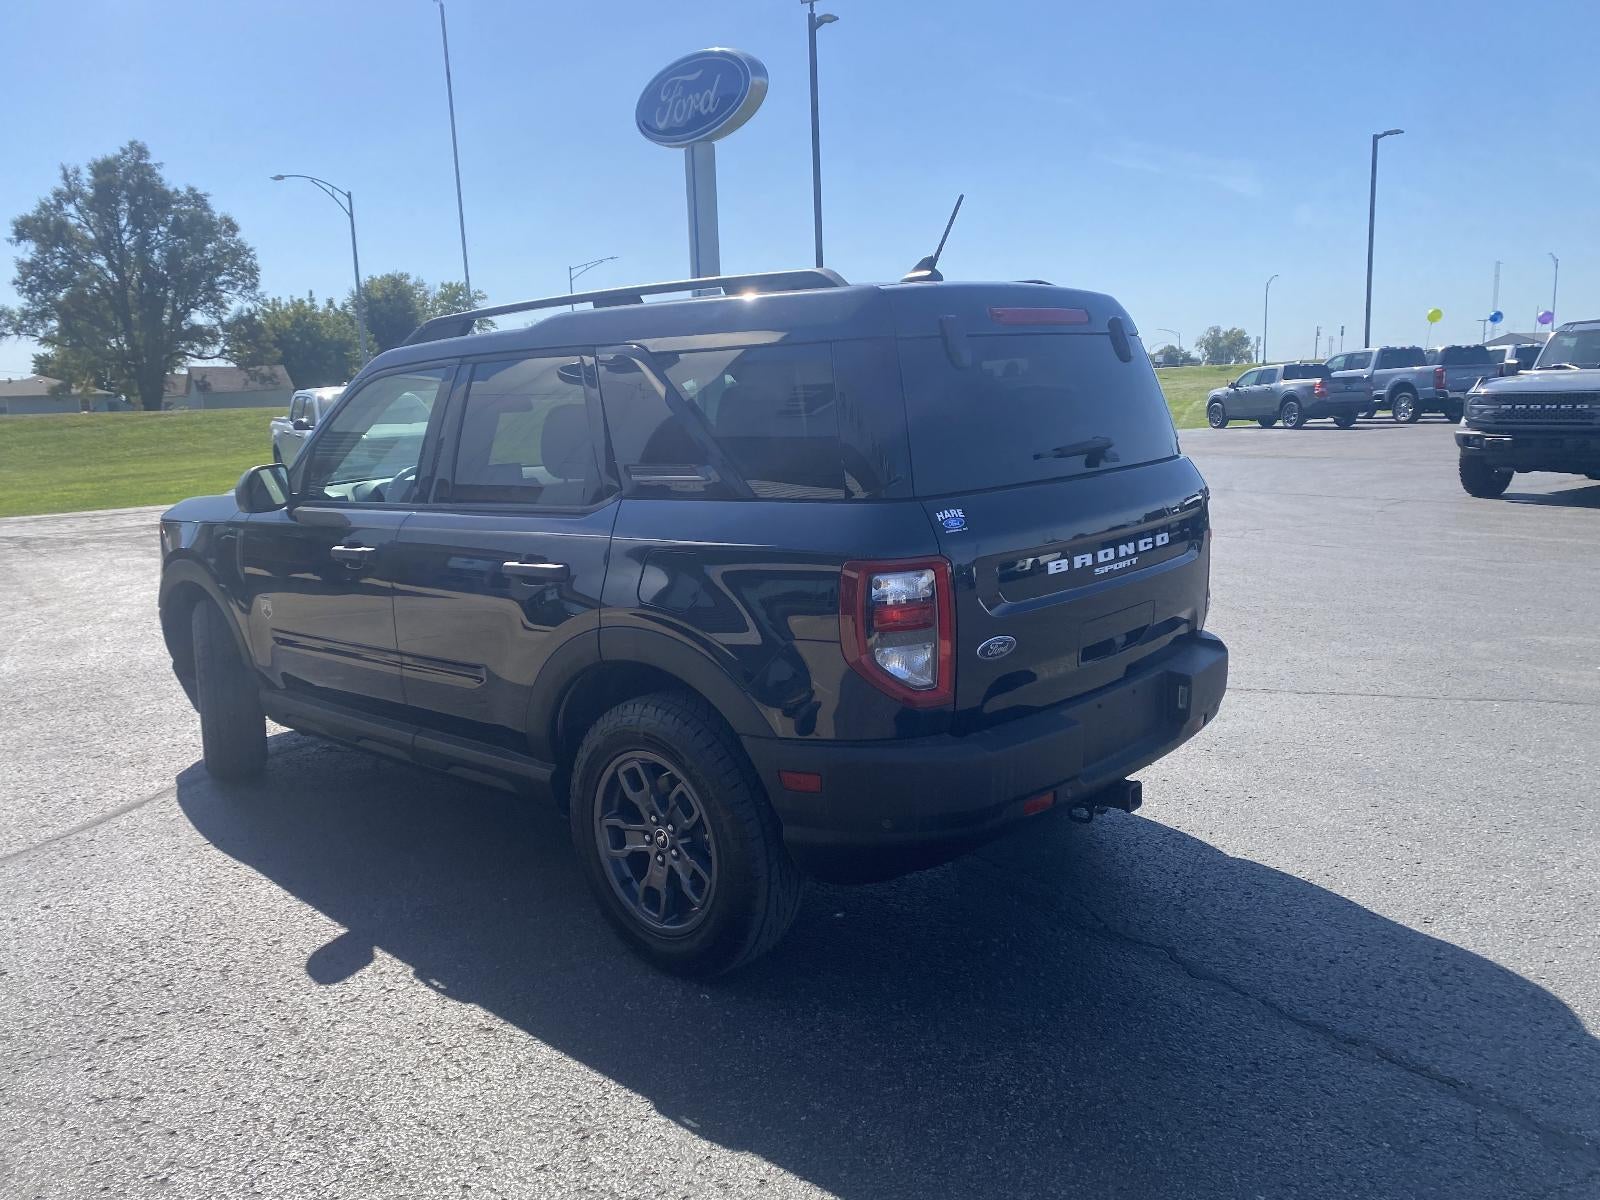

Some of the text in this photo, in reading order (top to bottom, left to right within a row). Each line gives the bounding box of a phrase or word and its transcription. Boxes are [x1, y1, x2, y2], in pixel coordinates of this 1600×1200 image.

[656, 70, 721, 130] Ford
[936, 509, 965, 521] HARE
[1047, 532, 1170, 575] BRONCO
[1094, 556, 1139, 575] SPORT
[987, 641, 1009, 656] Ford
